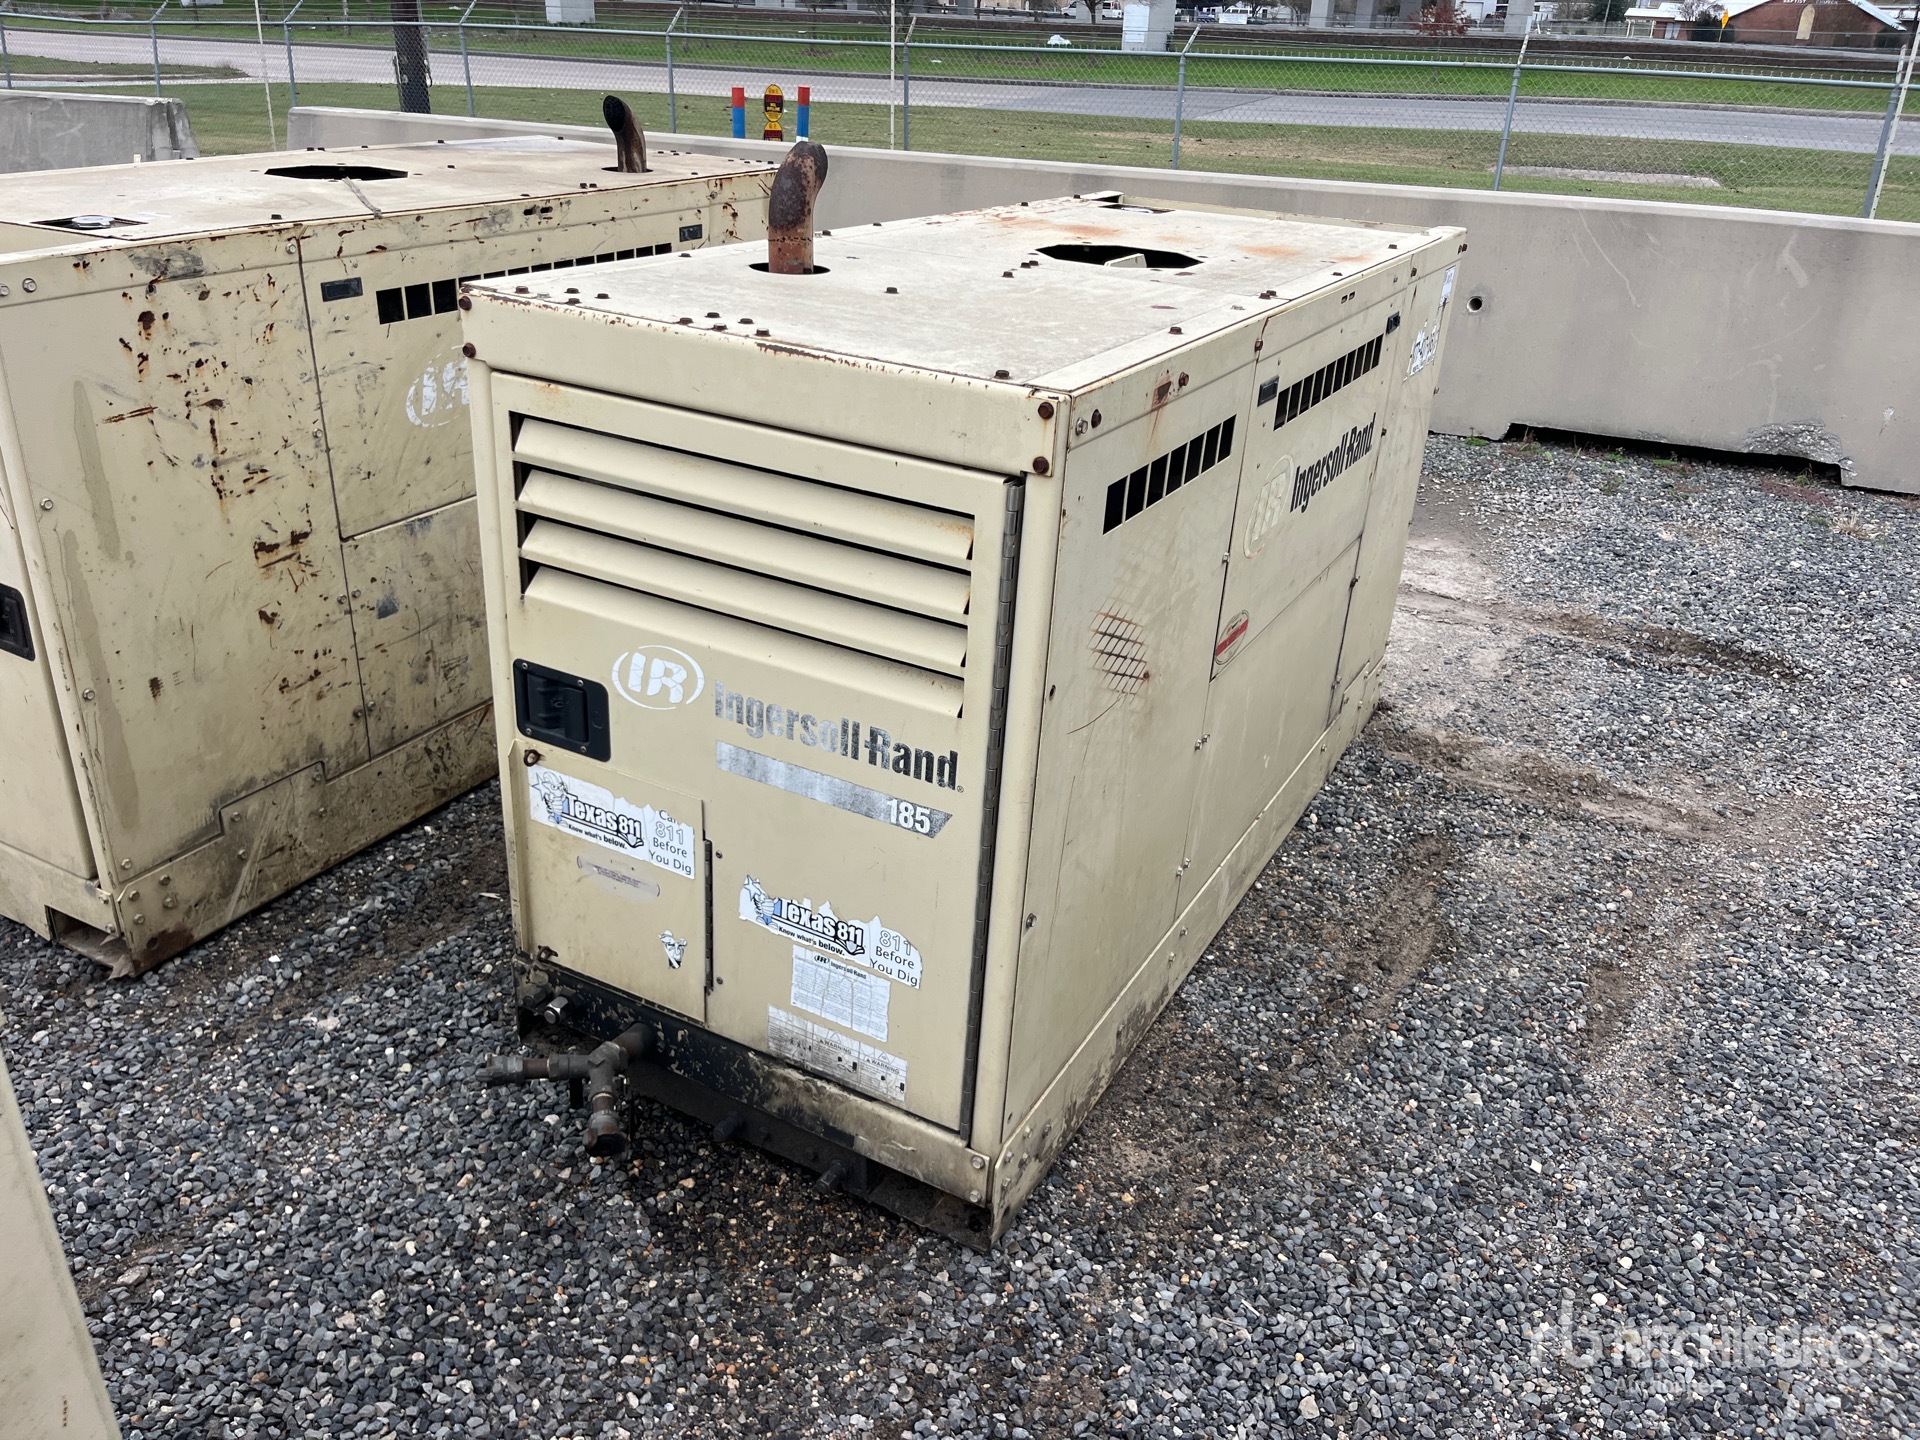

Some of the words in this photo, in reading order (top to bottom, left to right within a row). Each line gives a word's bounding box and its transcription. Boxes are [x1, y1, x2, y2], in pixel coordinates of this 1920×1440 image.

[628, 652, 688, 704] IR
[887, 799, 931, 835] 185
[568, 824, 584, 834] Know
[584, 830, 602, 842] what's
[655, 820, 684, 846] 811
[653, 837, 688, 858] Before
[649, 849, 670, 865] You
[673, 858, 692, 876] Dig
[778, 926, 796, 938] Know
[796, 933, 817, 946] what's
[818, 940, 845, 956] below.
[879, 930, 912, 956] 811
[875, 946, 915, 969] Before
[870, 958, 893, 976] You
[897, 969, 918, 988] Dig
[824, 1041, 852, 1055] WARNING
[871, 1058, 900, 1074] WARNING
